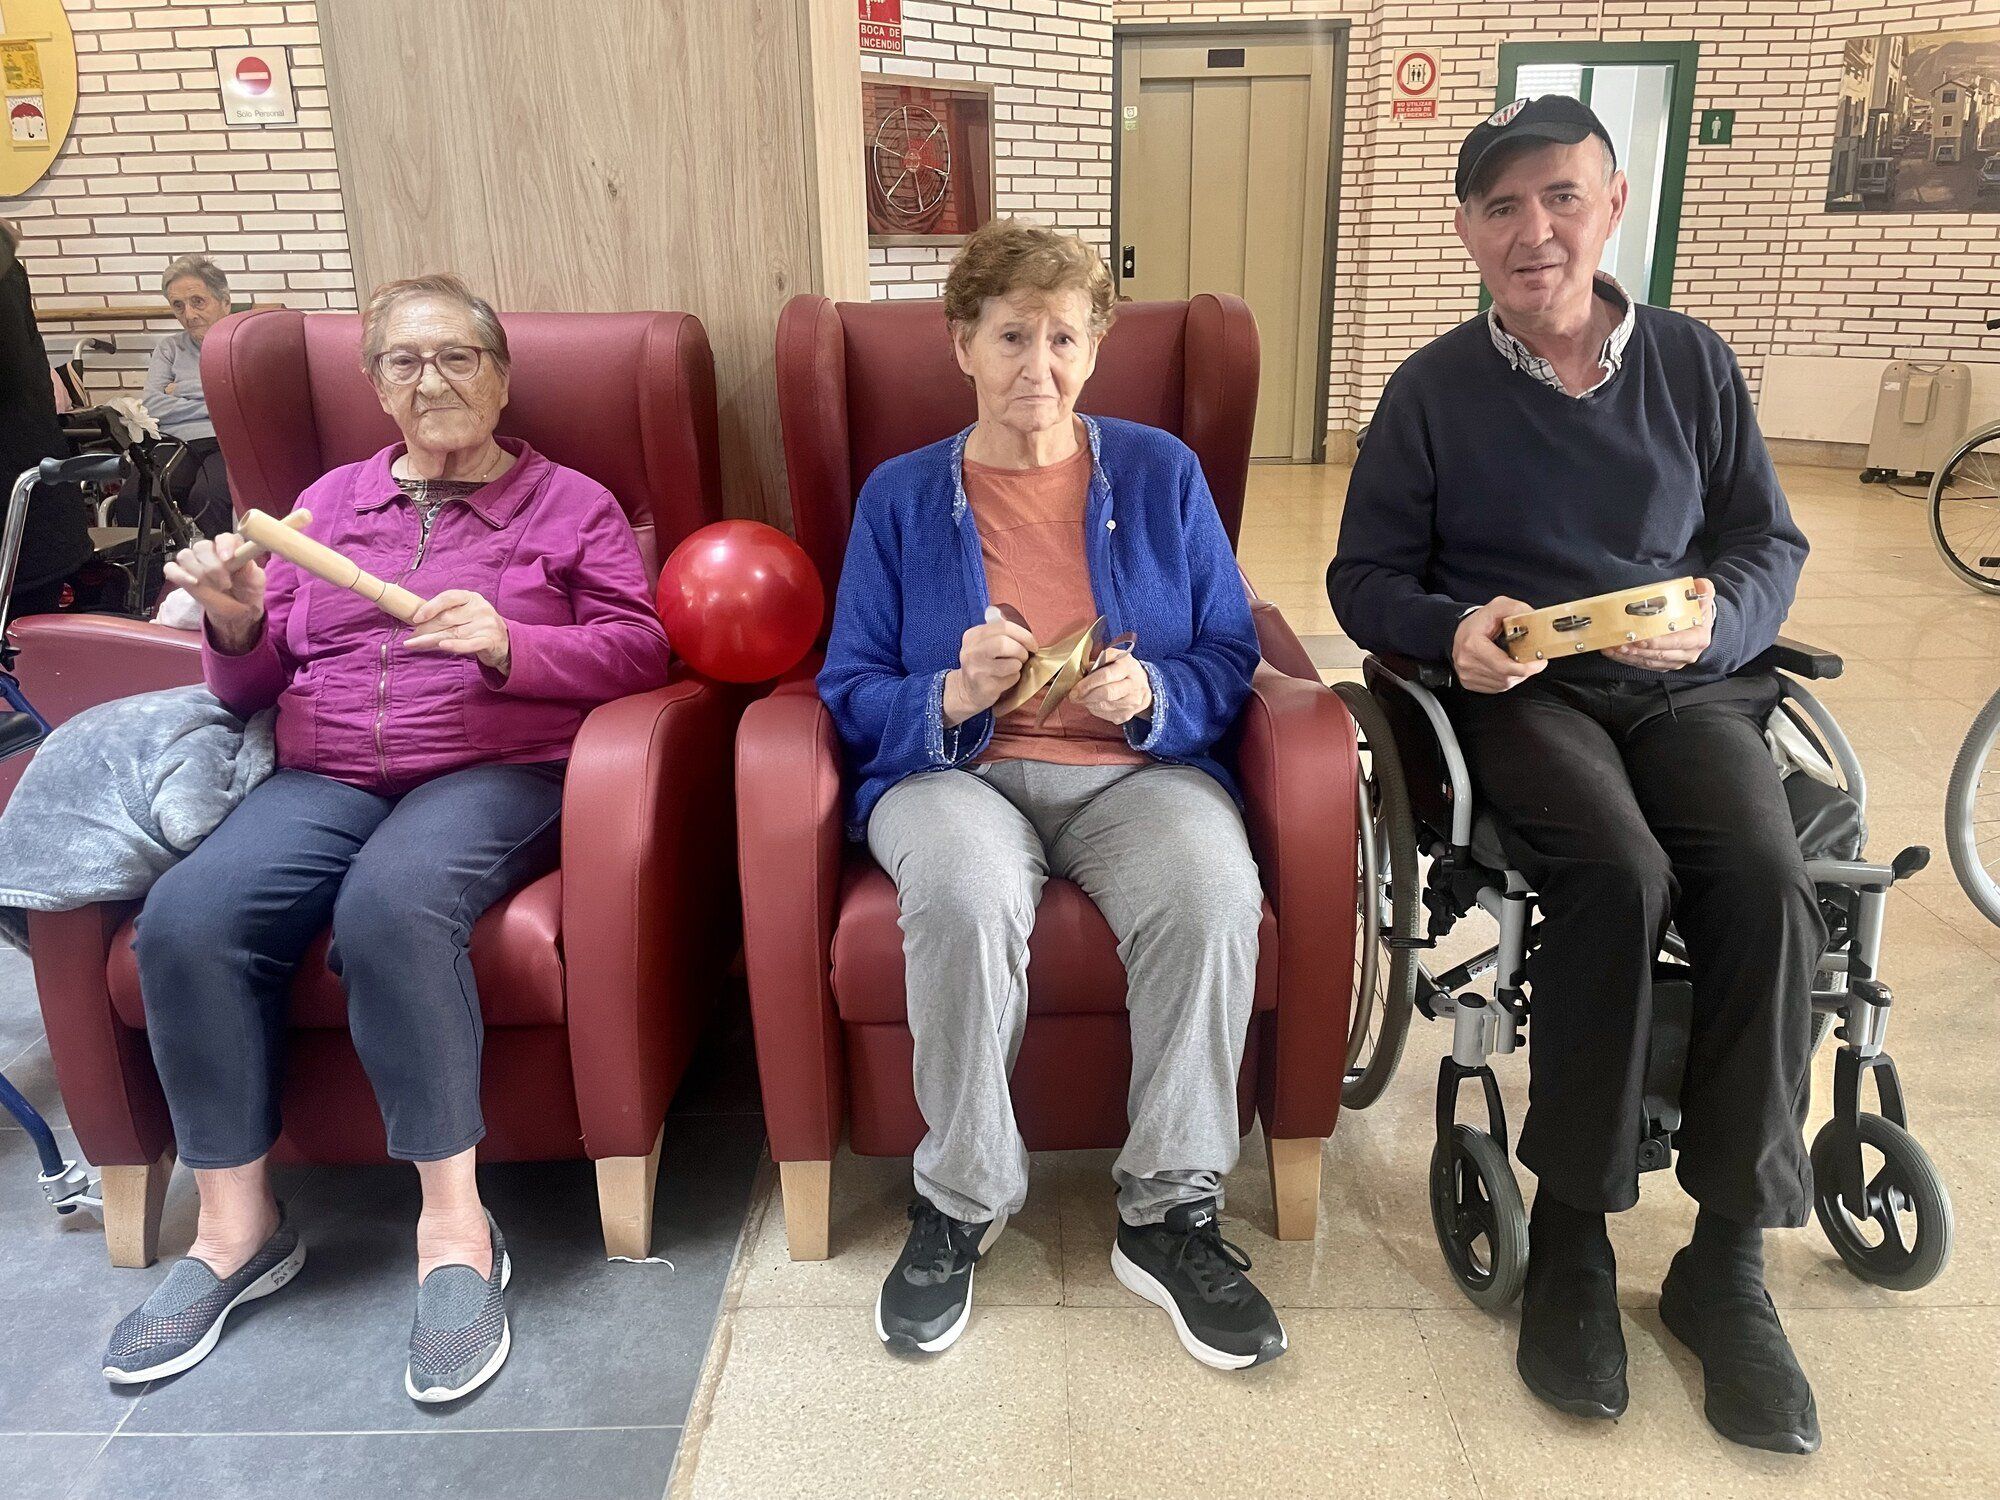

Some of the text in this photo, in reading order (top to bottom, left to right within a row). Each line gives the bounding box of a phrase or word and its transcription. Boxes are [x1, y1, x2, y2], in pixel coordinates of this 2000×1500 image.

[861, 24, 900, 37] BOCA DE
[861, 37, 901, 50] INCENDIO
[254, 109, 285, 118] Personal
